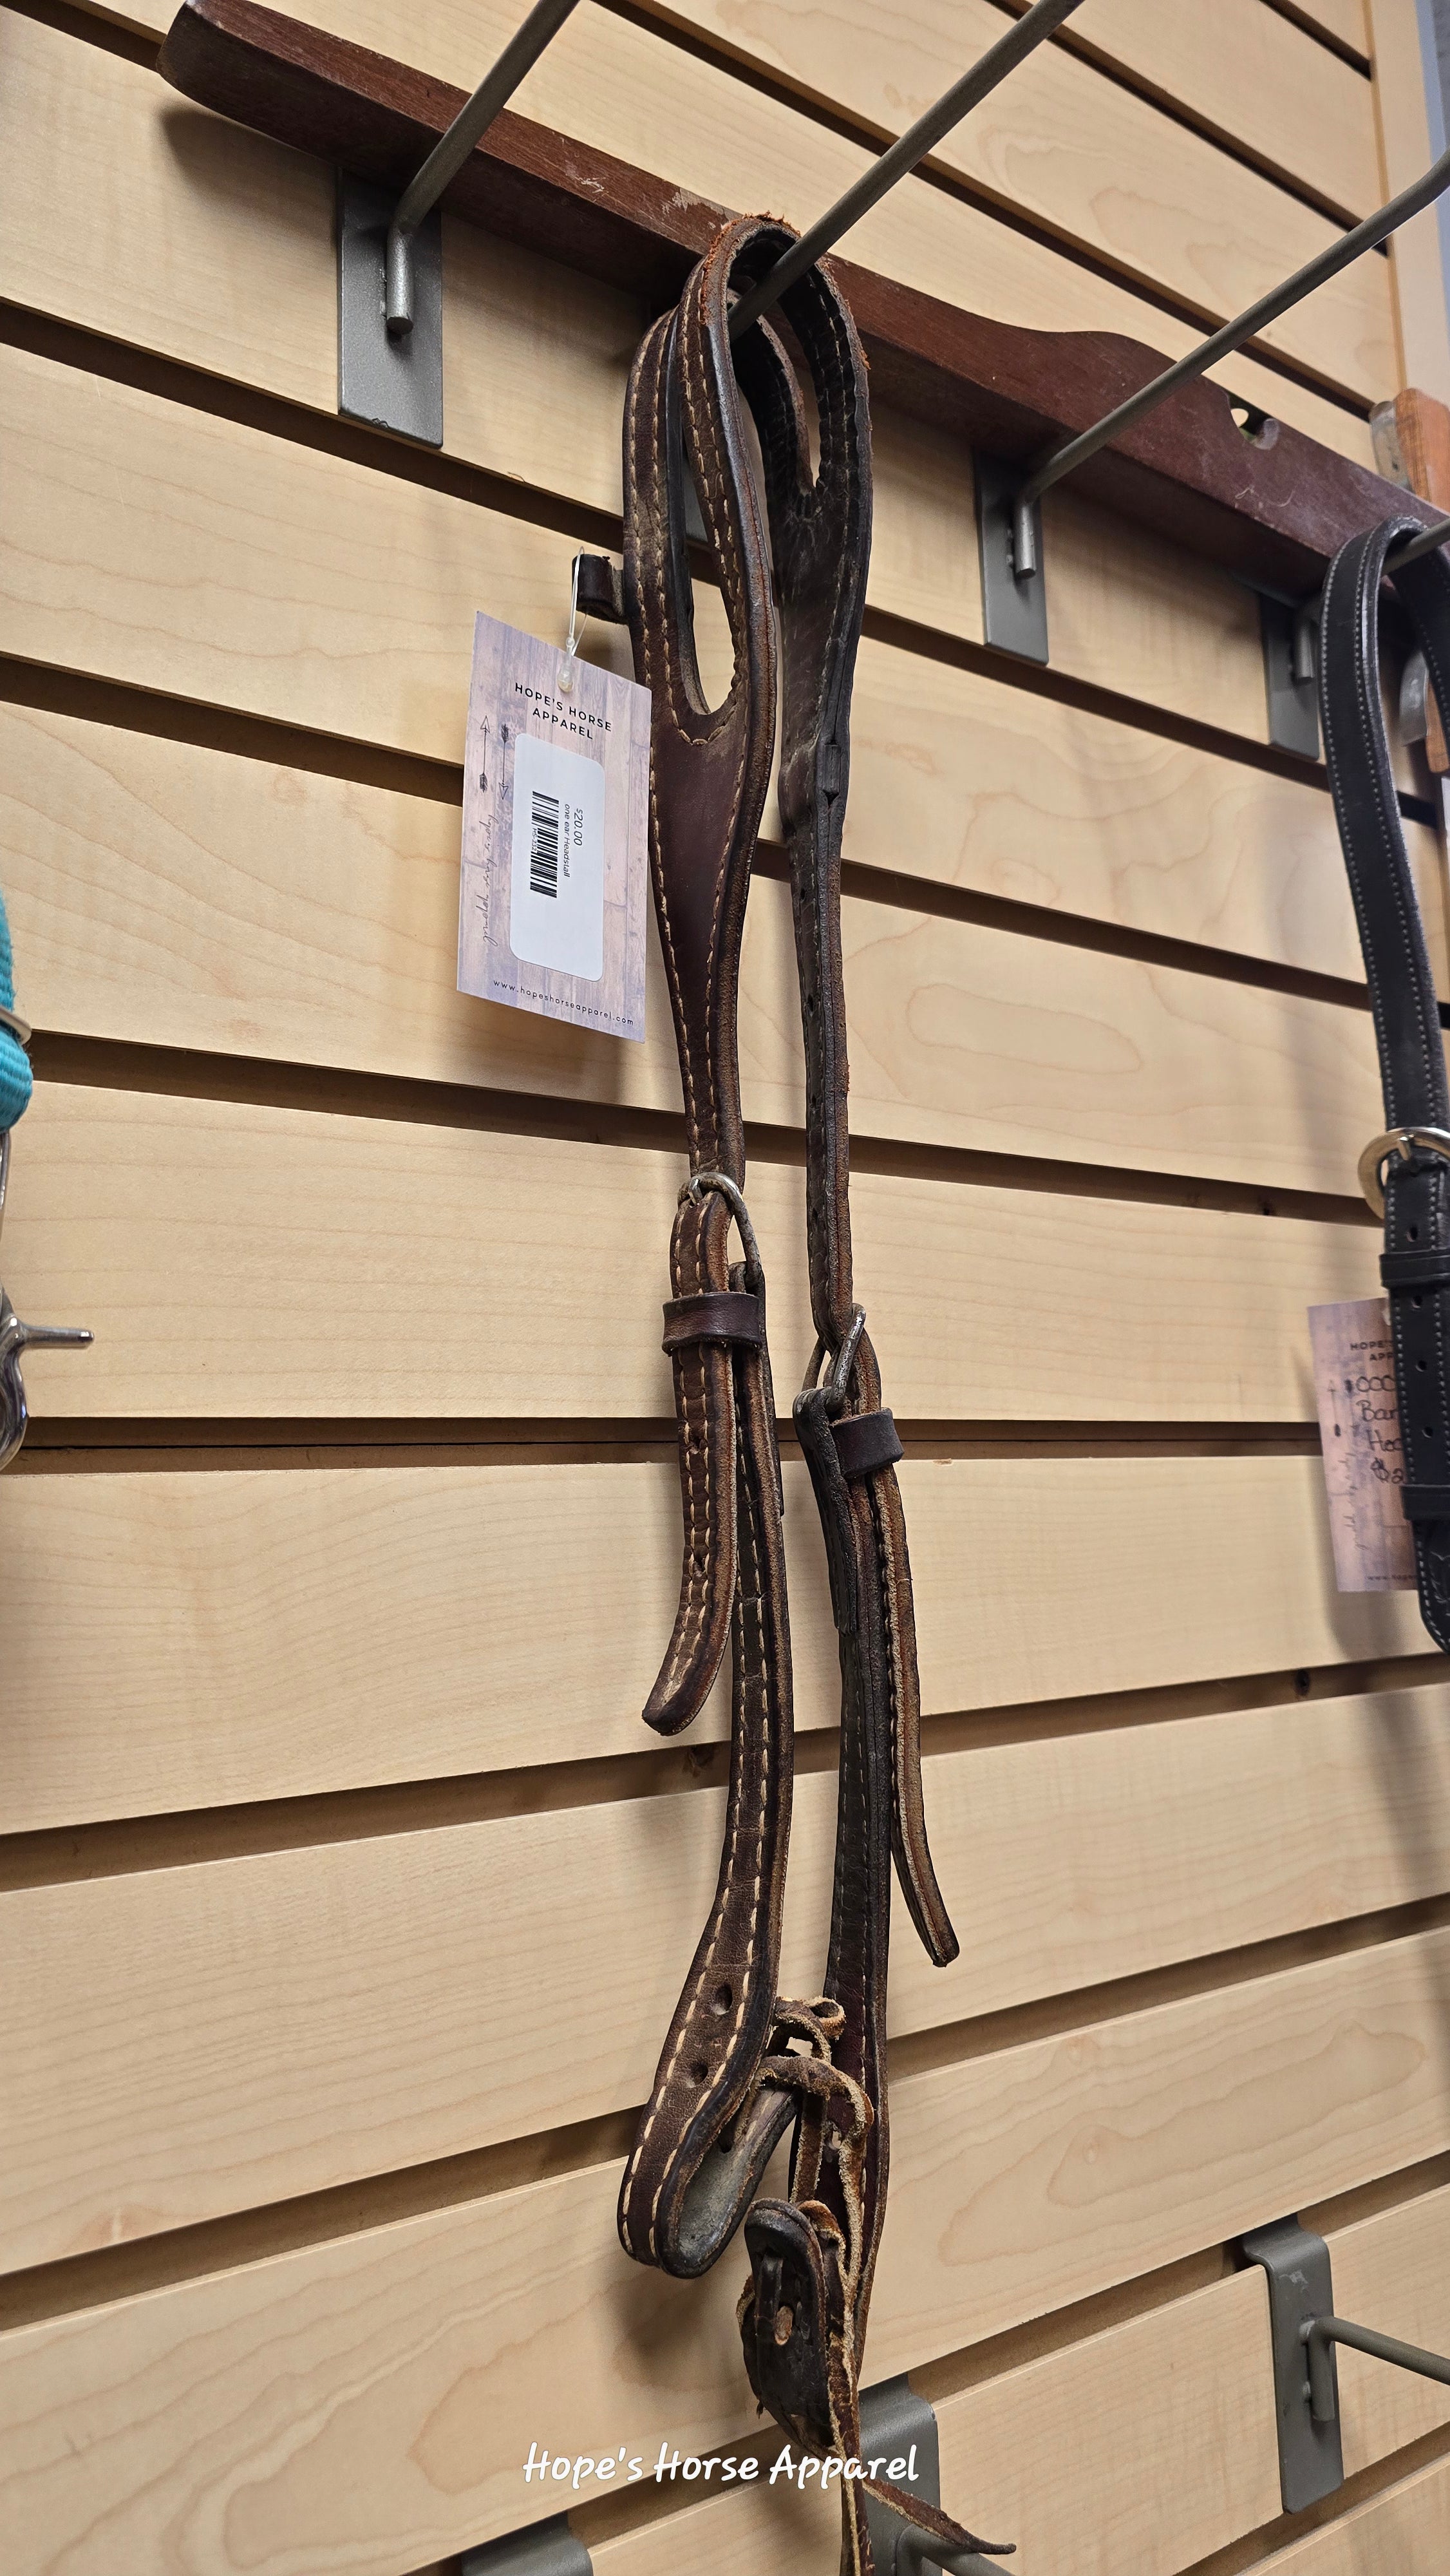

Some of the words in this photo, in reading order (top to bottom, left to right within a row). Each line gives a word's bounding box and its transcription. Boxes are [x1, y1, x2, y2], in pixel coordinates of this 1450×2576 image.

[515, 683, 563, 711] HOPE'S
[569, 706, 612, 732] HORSE
[532, 708, 593, 739] APPAREL
[573, 808, 583, 846] $20.00
[563, 837, 571, 878] Headstall
[493, 980, 634, 1026] www.hopeshorseapparel.com
